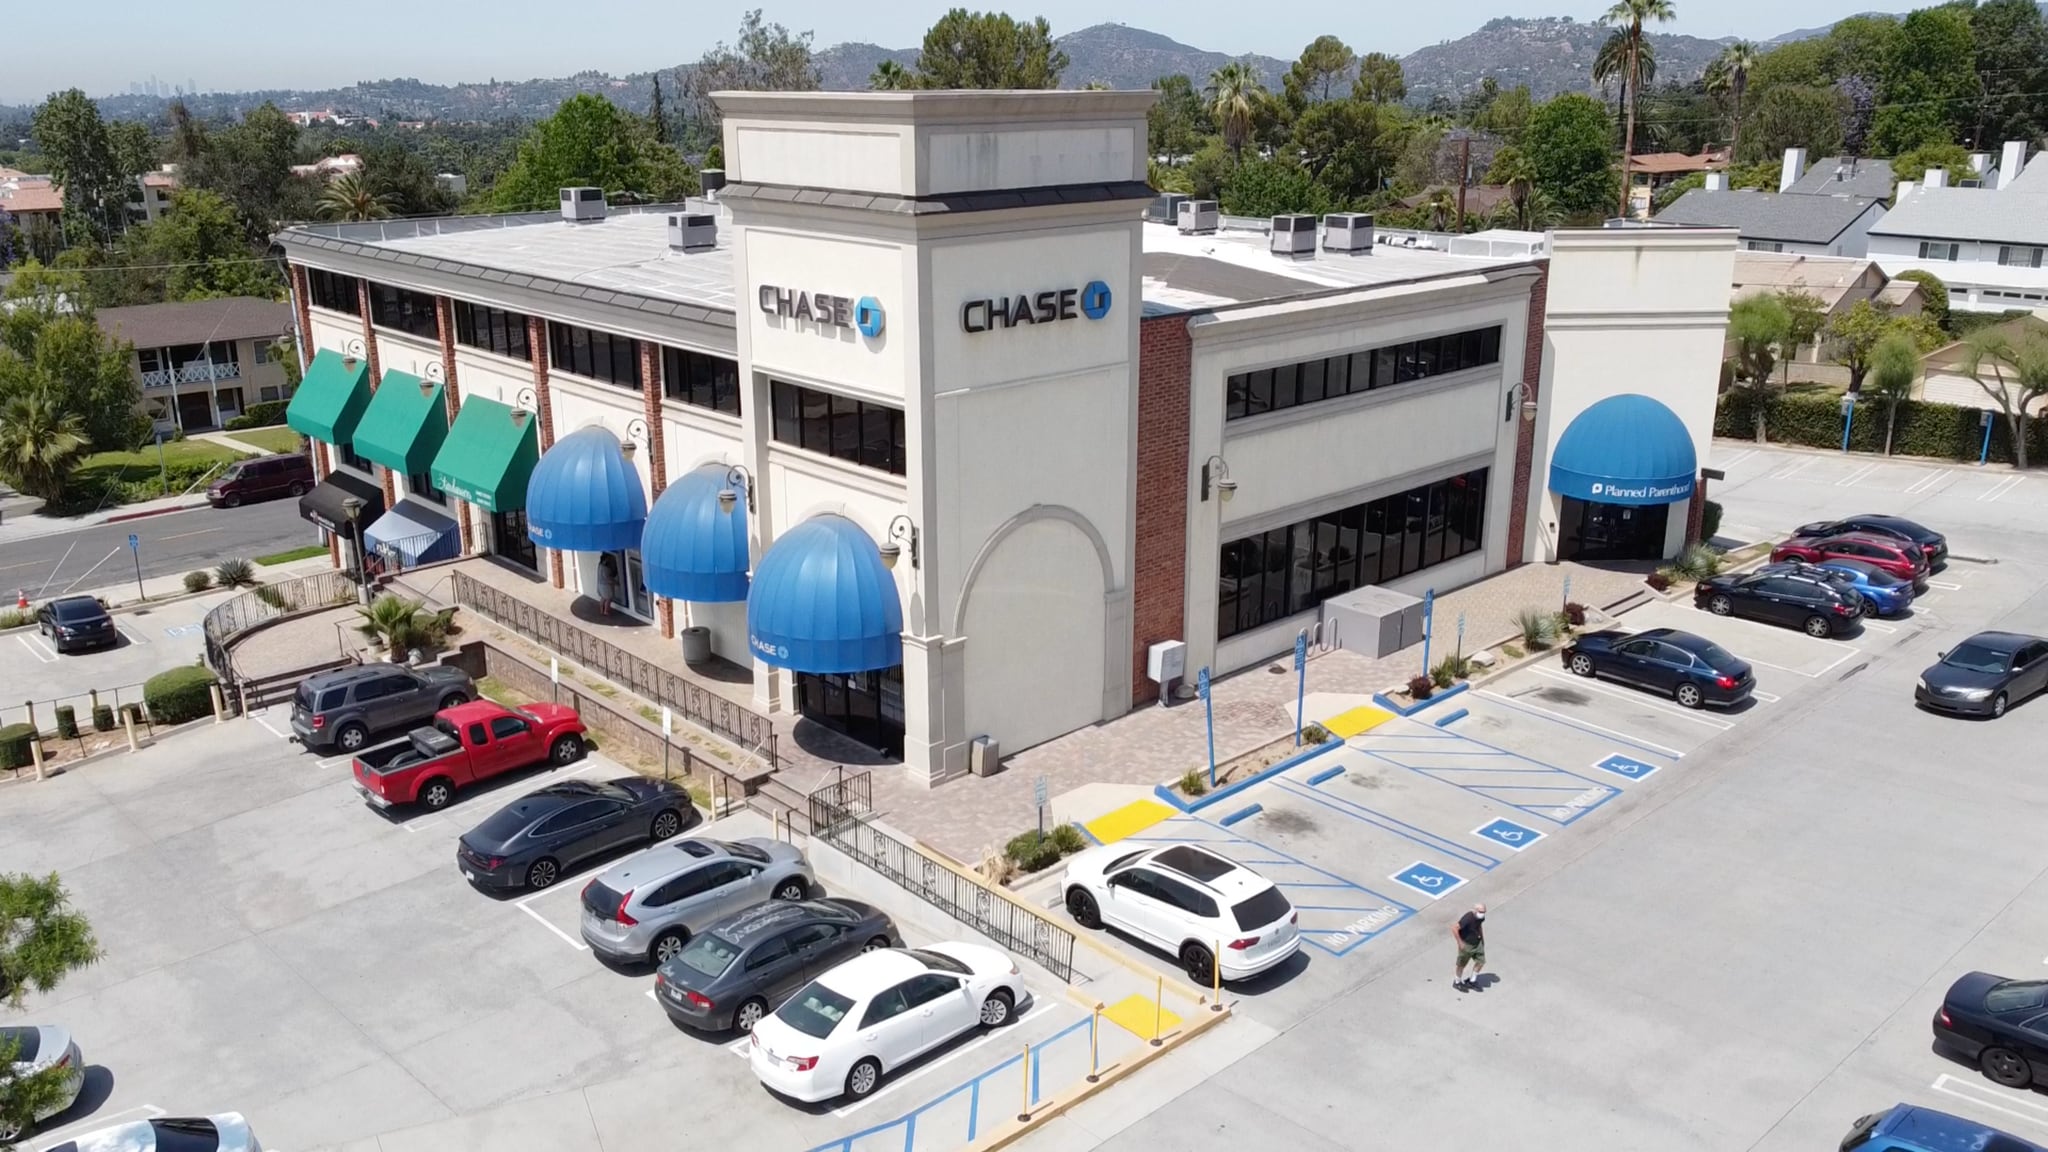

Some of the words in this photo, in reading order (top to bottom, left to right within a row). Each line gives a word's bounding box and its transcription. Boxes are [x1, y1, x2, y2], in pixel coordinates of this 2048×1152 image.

[759, 284, 851, 328] CHASE
[960, 288, 1078, 333] CHASE
[1605, 484, 1647, 498] Planned
[1649, 480, 1691, 498] Parenthood
[751, 634, 777, 656] CHASE
[1323, 932, 1349, 946] NO
[1344, 905, 1399, 935] PARKING
